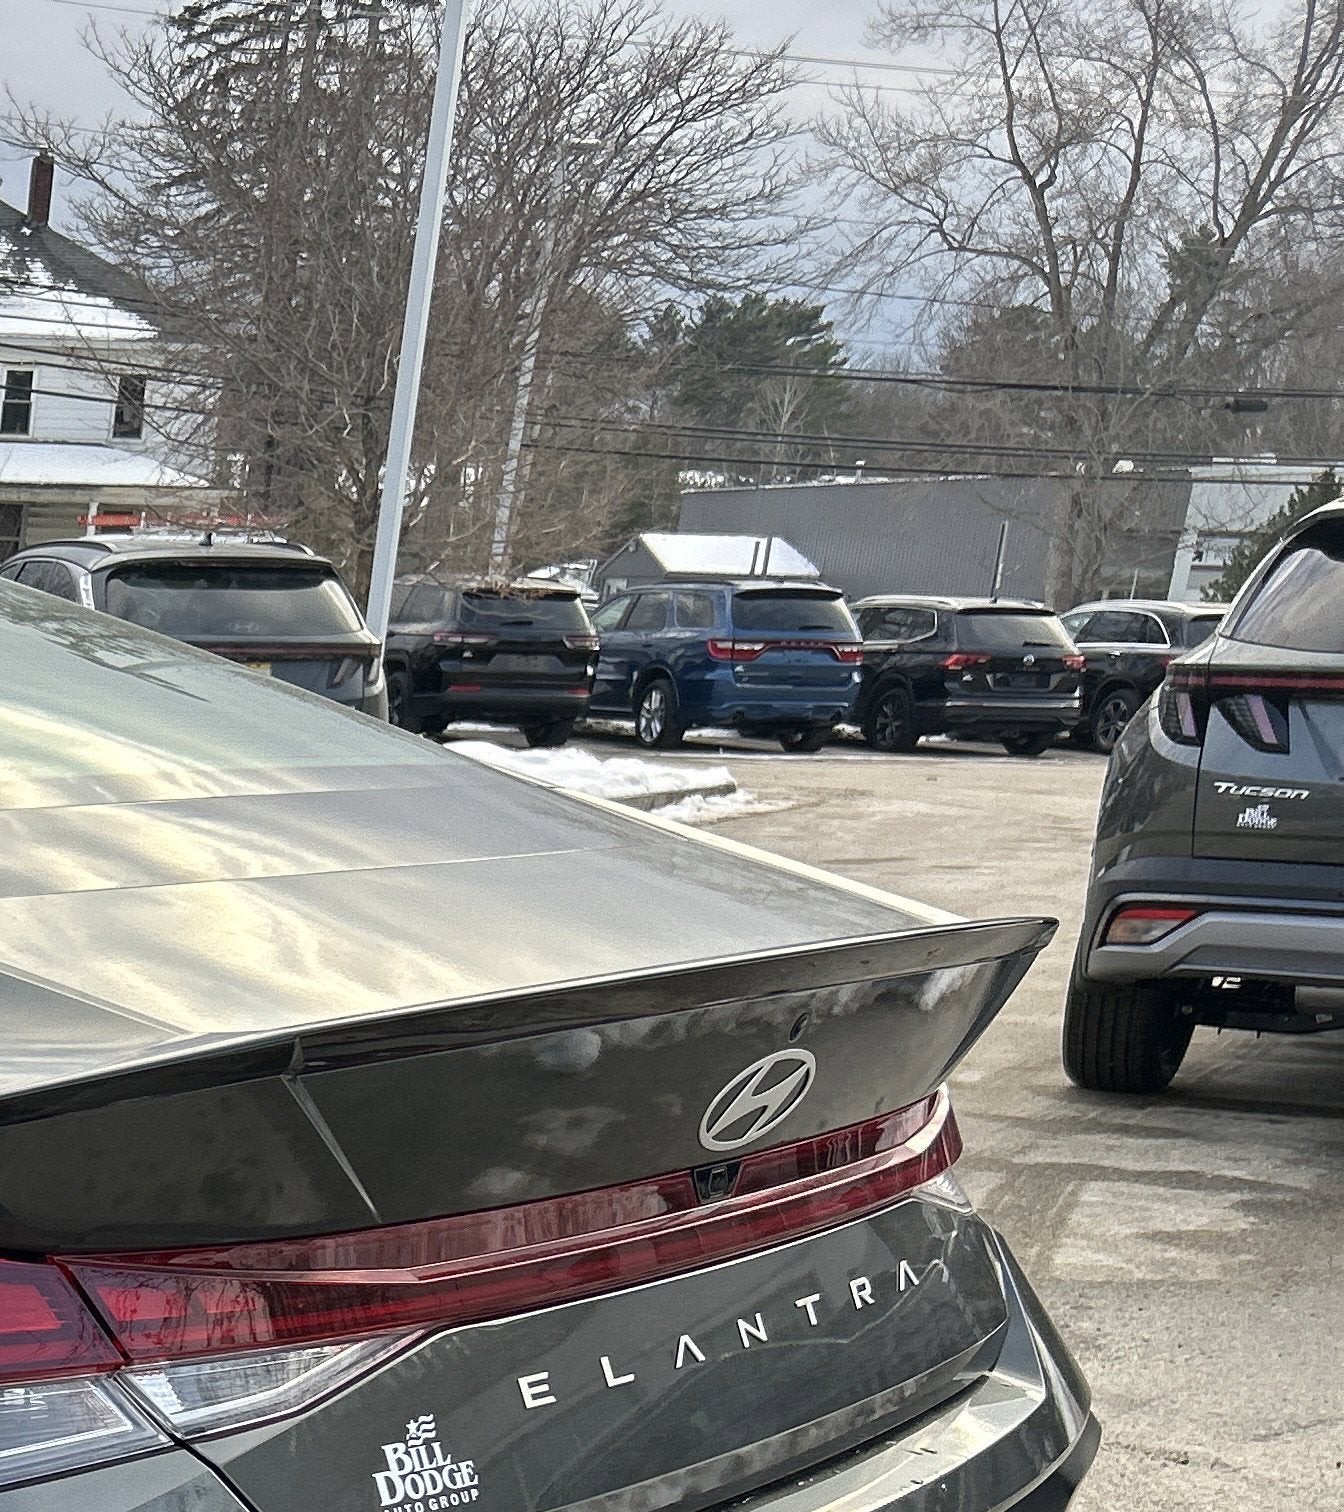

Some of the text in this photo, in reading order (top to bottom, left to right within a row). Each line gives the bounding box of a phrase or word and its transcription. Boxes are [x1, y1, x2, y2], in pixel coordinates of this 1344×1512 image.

[1214, 781, 1310, 800] TUCSON
[517, 1258, 920, 1410] ELANTRA
[380, 1441, 452, 1477] BILL
[371, 1459, 480, 1508] DODGE
[428, 1488, 480, 1512] GROUP
